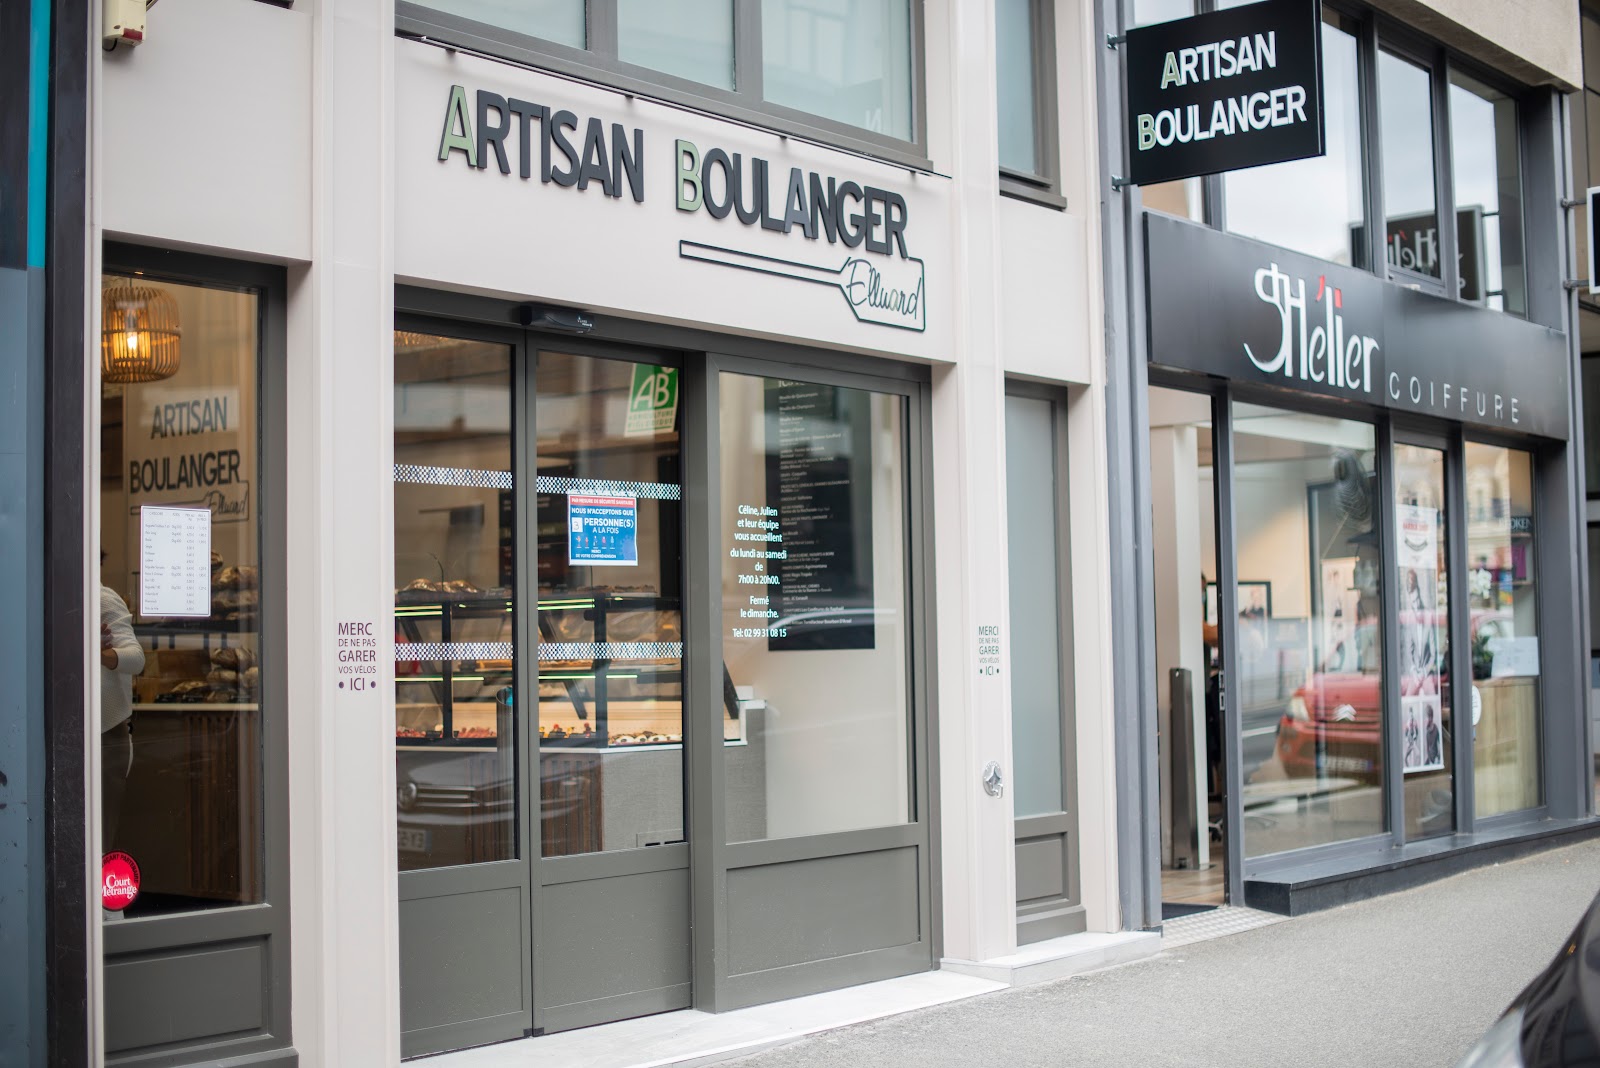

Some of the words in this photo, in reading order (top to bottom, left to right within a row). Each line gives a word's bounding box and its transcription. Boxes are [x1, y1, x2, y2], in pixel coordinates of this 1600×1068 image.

[1160, 31, 1276, 89] ARTISAN
[1137, 85, 1307, 151] BOULANGER
[438, 84, 644, 203] ARTISAN
[675, 138, 908, 259] BOULANGER
[633, 373, 670, 410] AB
[1389, 371, 1519, 424] COIFFURE
[150, 396, 227, 440] ARTISAN
[129, 449, 241, 494] BOULANGER
[738, 505, 759, 516] Céline,
[760, 506, 778, 516] Julien
[584, 518, 634, 528] PERSONNE(S)
[745, 519, 757, 528] leur
[758, 520, 779, 530] équipe
[750, 533, 782, 542] accueillent
[730, 548, 739, 557] du
[740, 548, 756, 558] lundi
[765, 550, 787, 559] samedi
[755, 562, 763, 571] de
[738, 575, 754, 584] 7h00
[755, 575, 759, 584] à
[750, 596, 769, 605] Fermé
[740, 609, 746, 617] le
[747, 609, 779, 618] dimanche.
[338, 622, 372, 635] MERC
[732, 628, 743, 637] Tel:
[744, 629, 752, 637] 02
[753, 629, 761, 637] 99
[762, 629, 769, 637] 31
[770, 629, 778, 638] 08
[779, 629, 787, 638] 15
[979, 626, 999, 636] MERCI
[338, 638, 348, 647] DE
[350, 638, 360, 647] NE
[362, 638, 376, 647] PAS
[338, 650, 376, 662] GARER
[979, 646, 1000, 655] GARER
[338, 666, 353, 674] VOS
[354, 664, 376, 674] VÉLOS
[350, 678, 364, 690] ICI
[106, 874, 131, 888] Court
